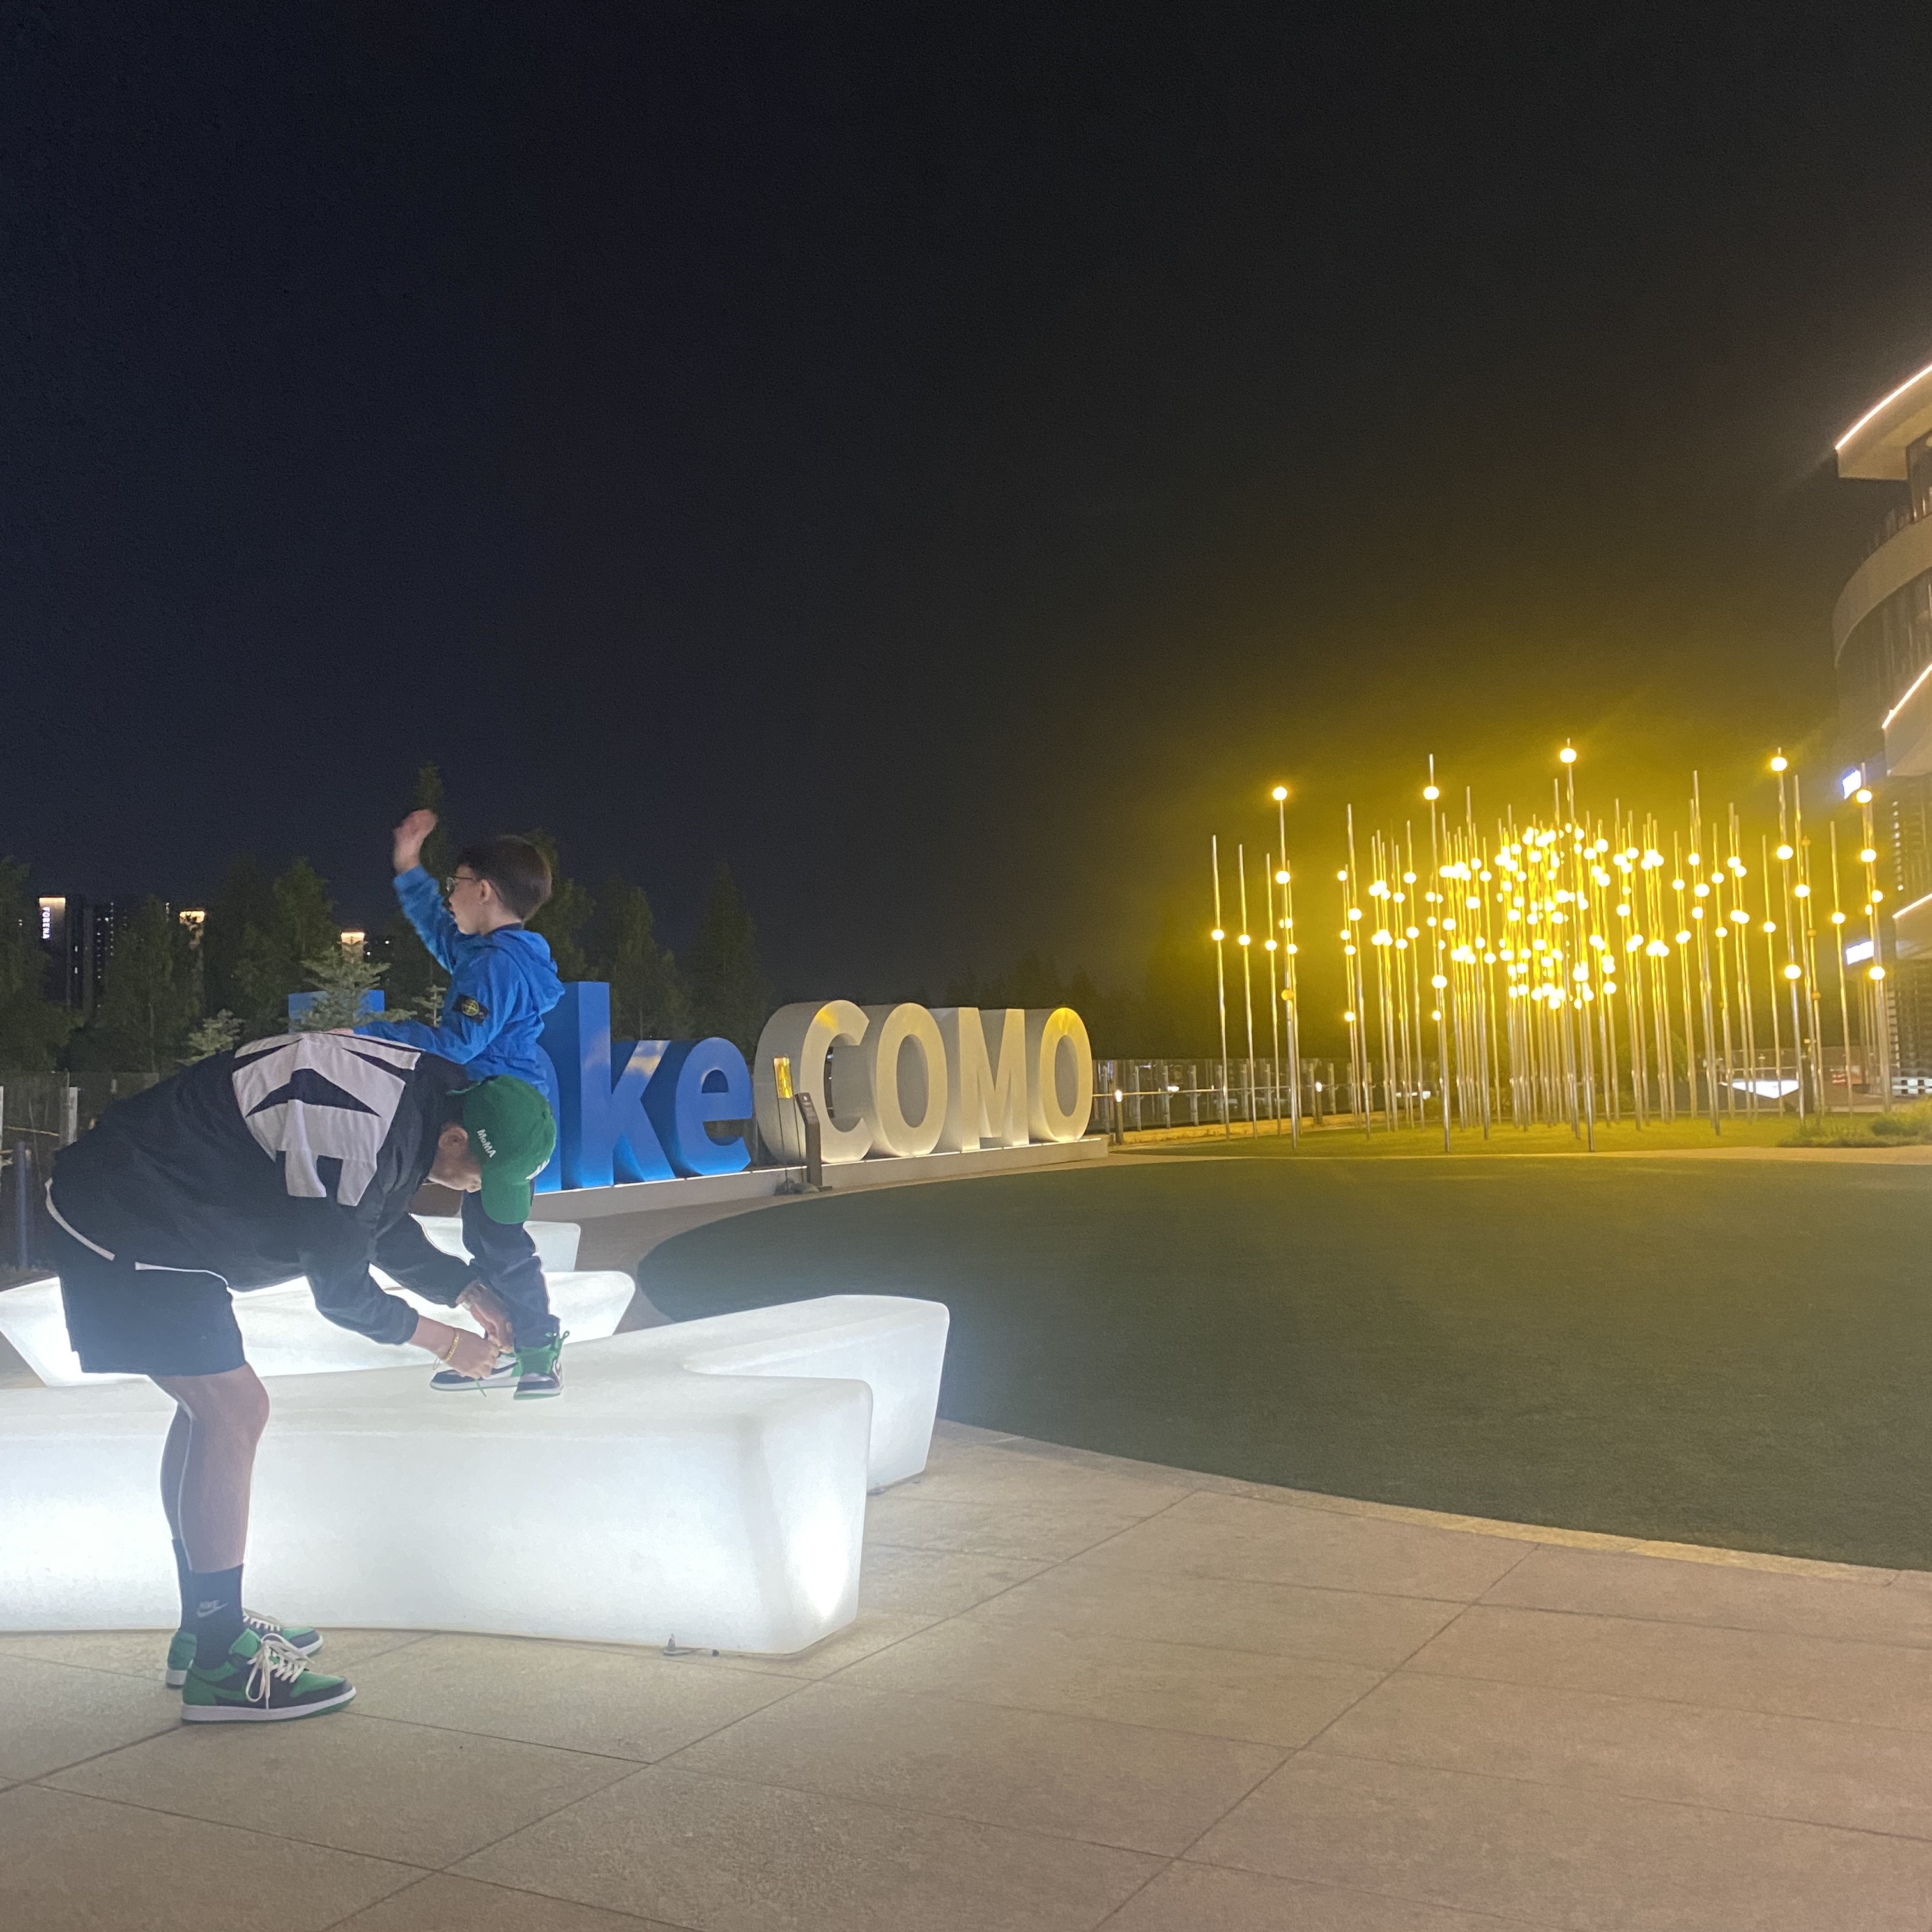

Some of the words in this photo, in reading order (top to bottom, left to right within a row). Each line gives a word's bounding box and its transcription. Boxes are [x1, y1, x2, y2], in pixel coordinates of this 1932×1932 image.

[42, 907, 51, 940] FORENA
[754, 999, 1093, 1164] COMO
[477, 1129, 496, 1158] MoMA
